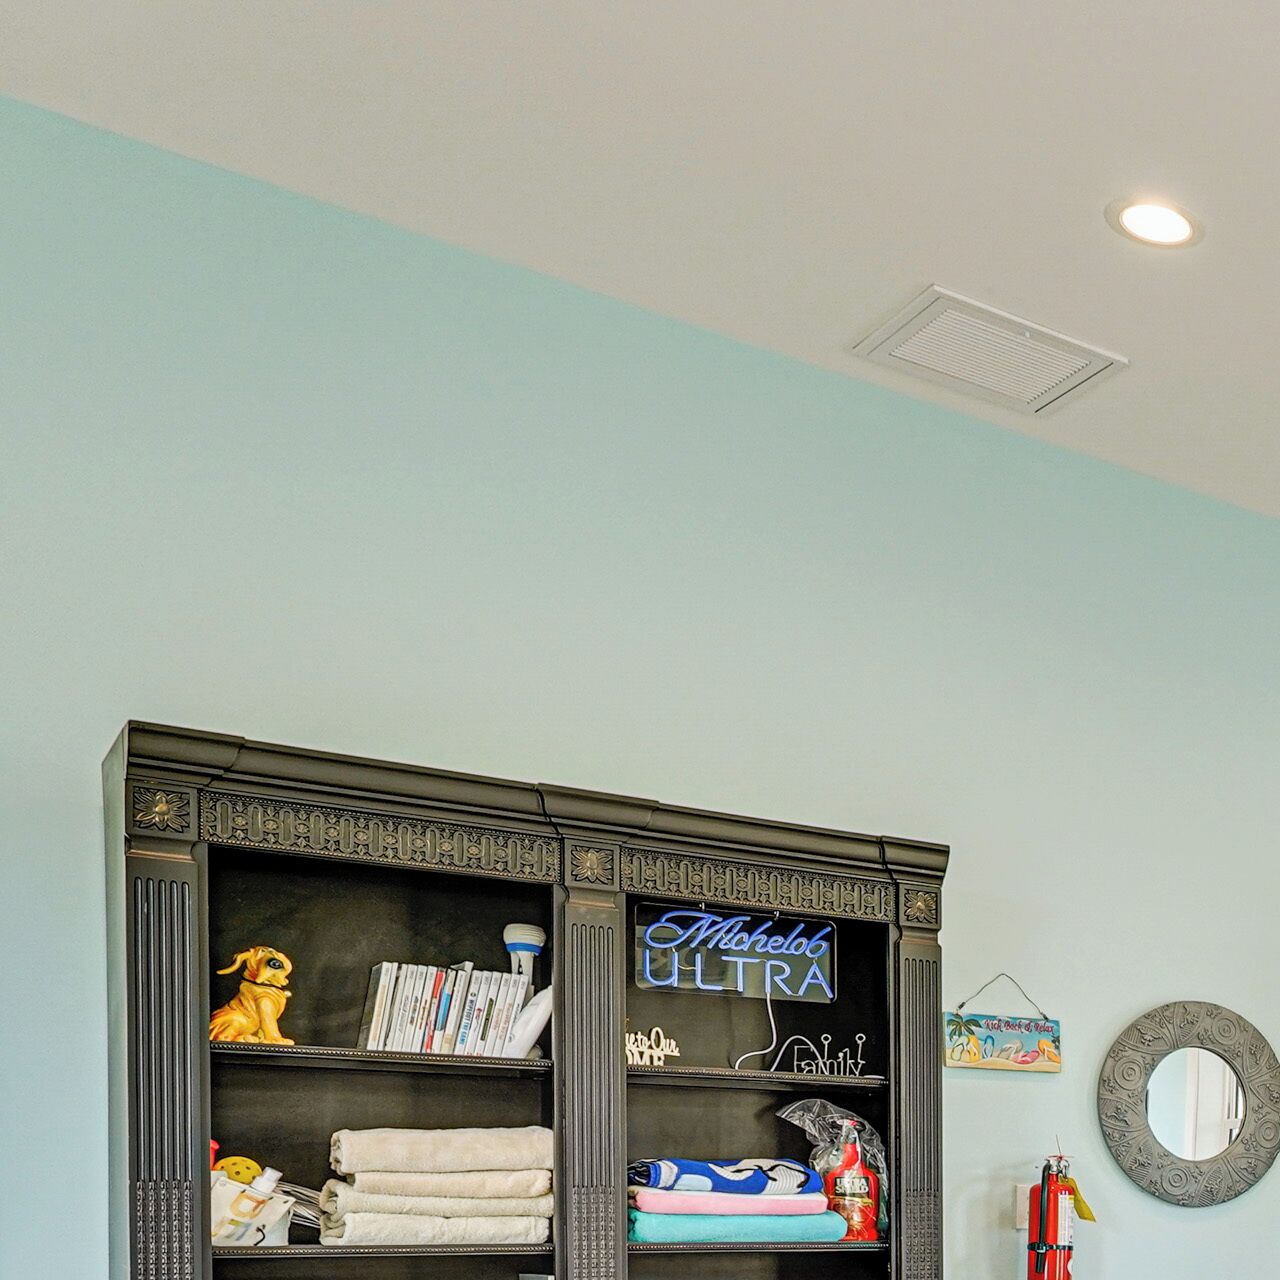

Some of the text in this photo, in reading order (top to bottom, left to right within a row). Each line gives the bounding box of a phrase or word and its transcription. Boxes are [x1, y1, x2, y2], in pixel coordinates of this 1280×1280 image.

[644, 910, 832, 958] Michelob
[644, 949, 834, 999] ULTRA
[464, 998, 475, 1021] WIPEOUT
[984, 1019, 1055, 1034] Kick Back & Relax
[650, 1027, 680, 1053] Our
[626, 1050, 665, 1066] OME
[794, 1045, 866, 1078] Family
